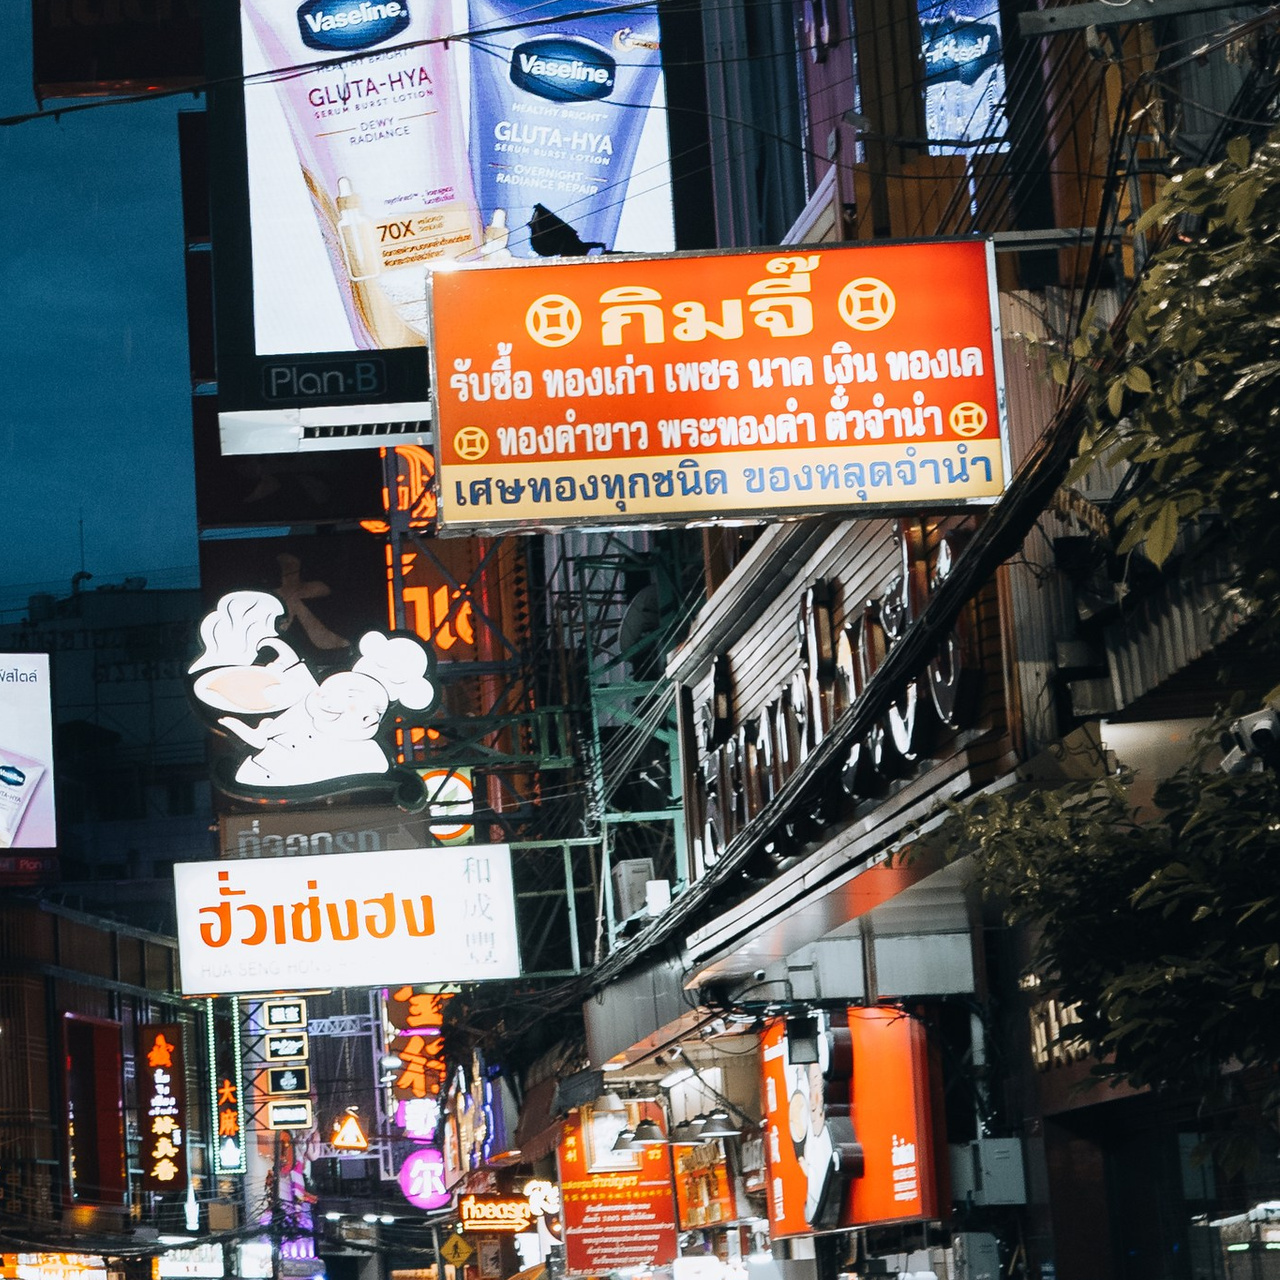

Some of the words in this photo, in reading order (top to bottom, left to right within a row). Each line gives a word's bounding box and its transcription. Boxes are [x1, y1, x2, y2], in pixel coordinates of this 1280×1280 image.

[304, 0, 402, 34] Vaseline
[520, 53, 610, 84] Vaseline
[308, 66, 433, 108] GLUTA-HYA
[315, 105, 349, 119] SERUM
[354, 97, 388, 113] BURST
[393, 88, 435, 105] LOTION
[349, 125, 411, 146] RADIANCE
[360, 116, 394, 132] DEWY
[494, 120, 613, 156] GLUTA-HYA
[496, 172, 554, 191] RADIANCE
[513, 163, 584, 182] OVERNIGHT
[376, 219, 415, 242] 70X
[448, 343, 533, 403] รับซื้อ
[543, 354, 655, 399] ทองเก่า
[665, 358, 739, 393] เพชร
[749, 357, 812, 388] นาค
[824, 340, 878, 388] เงิน
[886, 344, 984, 382] ทองเค
[496, 411, 649, 457] ทองคำขาว
[657, 398, 816, 450] พระทองคำ
[825, 385, 943, 442] ตั๋วจำนำ
[454, 458, 729, 513] เศษทองทุกชนิด
[743, 445, 993, 503] ของหลุดจำนำ
